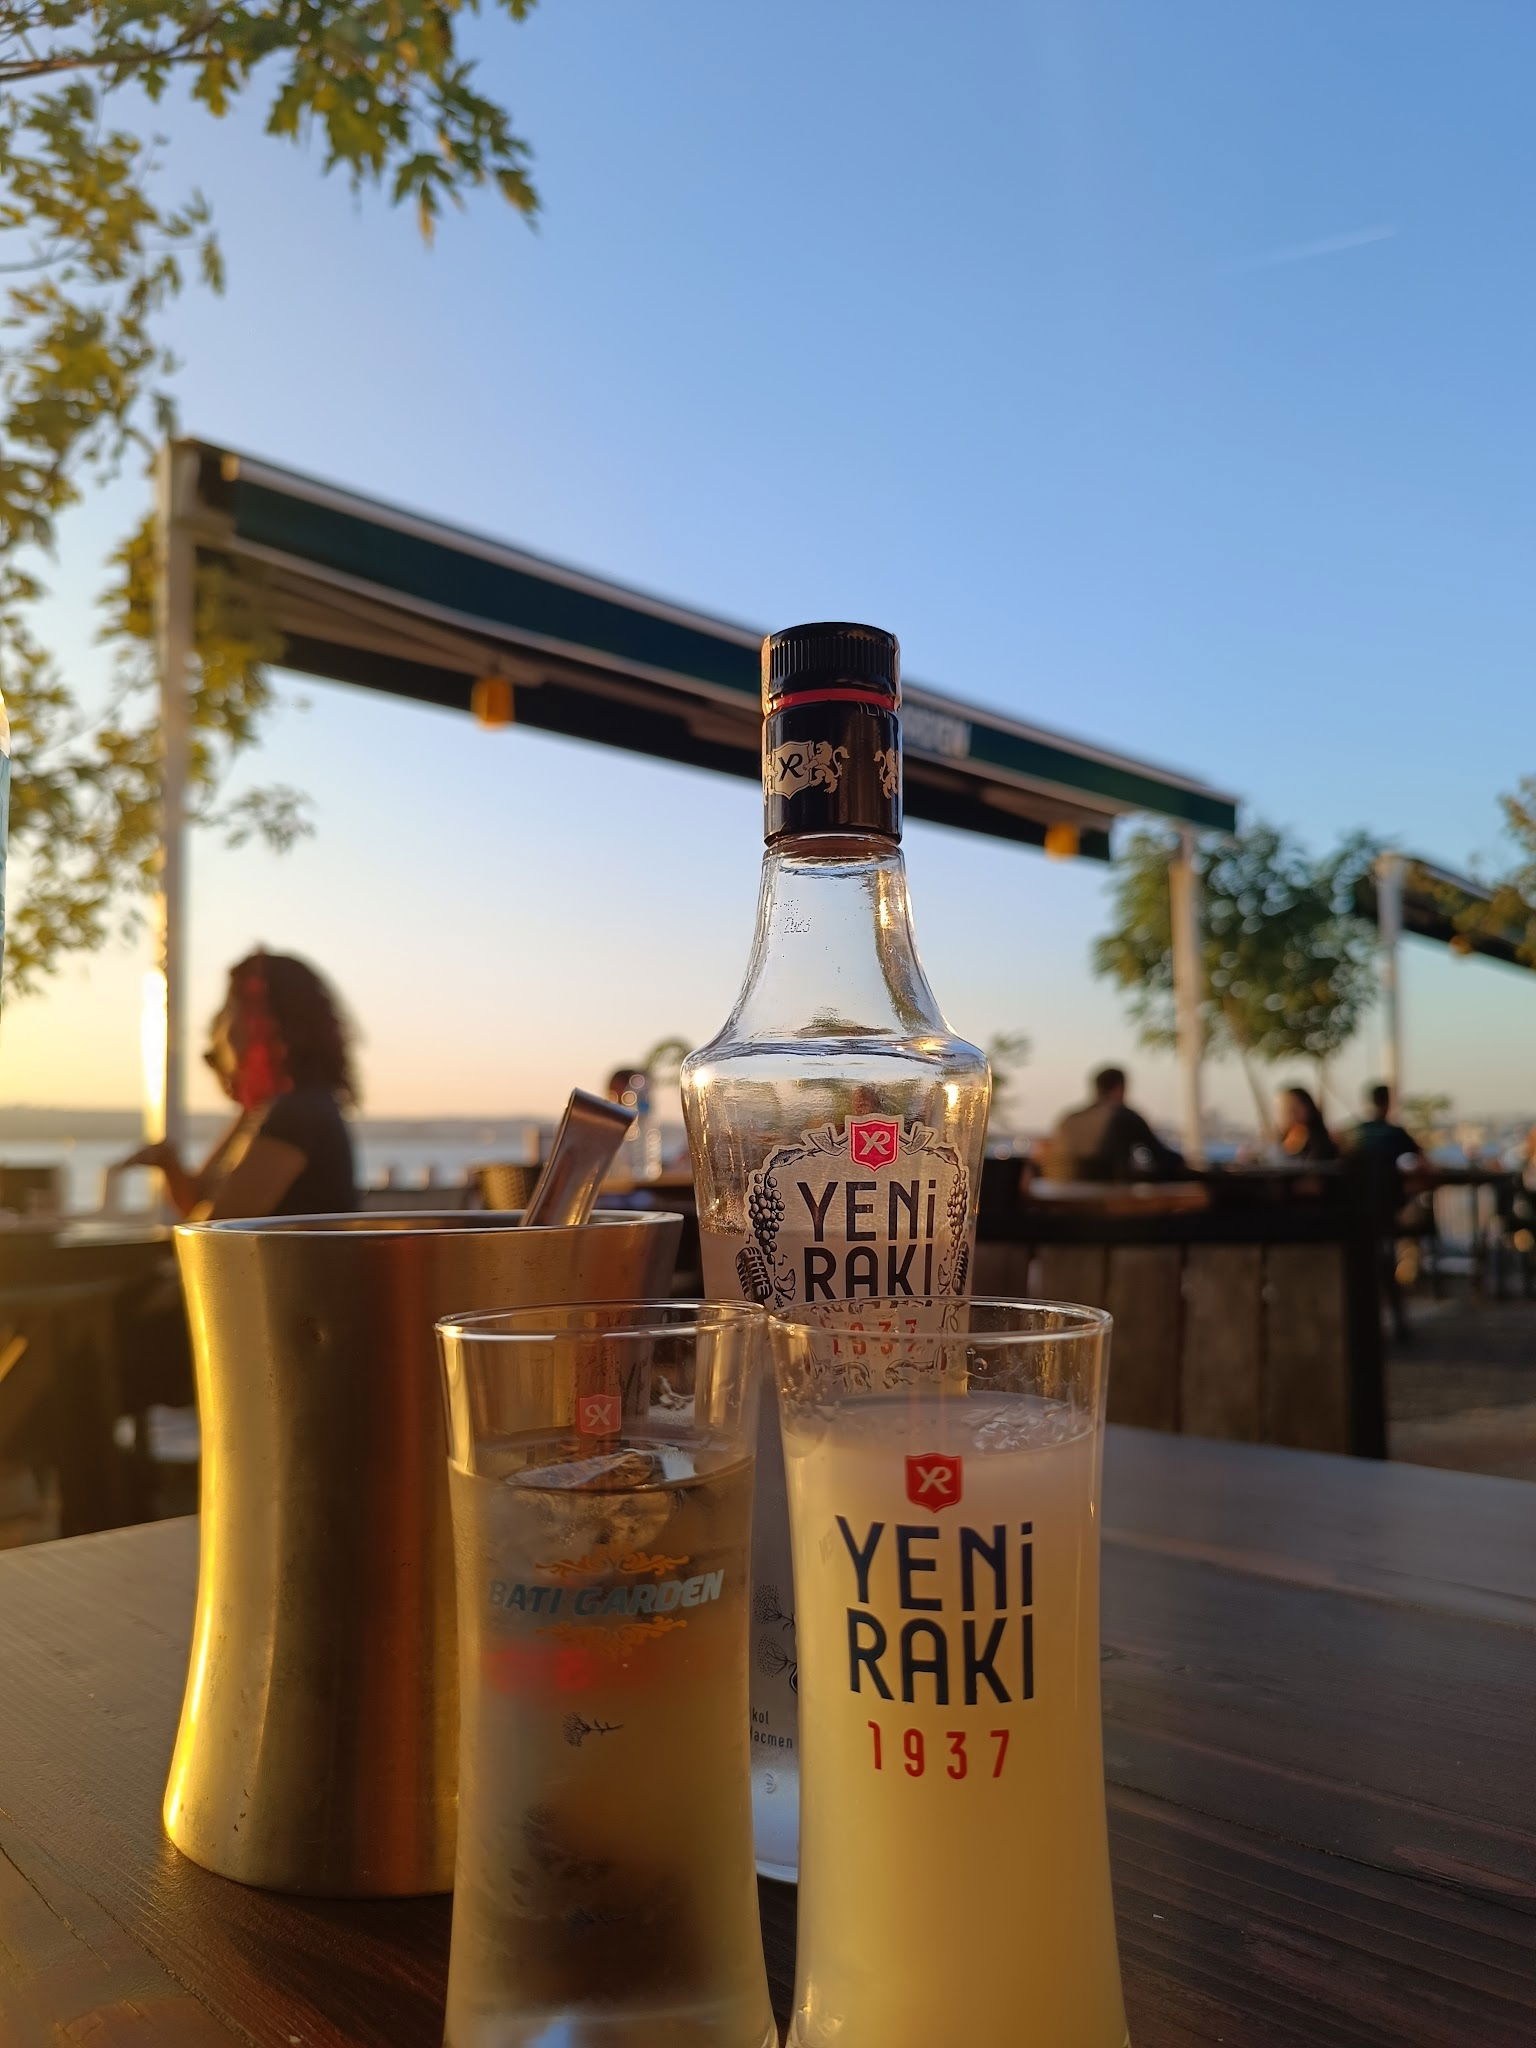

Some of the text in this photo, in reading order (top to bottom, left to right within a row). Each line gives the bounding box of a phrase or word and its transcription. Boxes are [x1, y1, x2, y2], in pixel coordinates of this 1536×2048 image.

[572, 1568, 725, 1617] GARDEN
[847, 1607, 1034, 1706] RAKI
[751, 1706, 769, 1724] kol
[867, 1719, 1010, 1780] 1937
